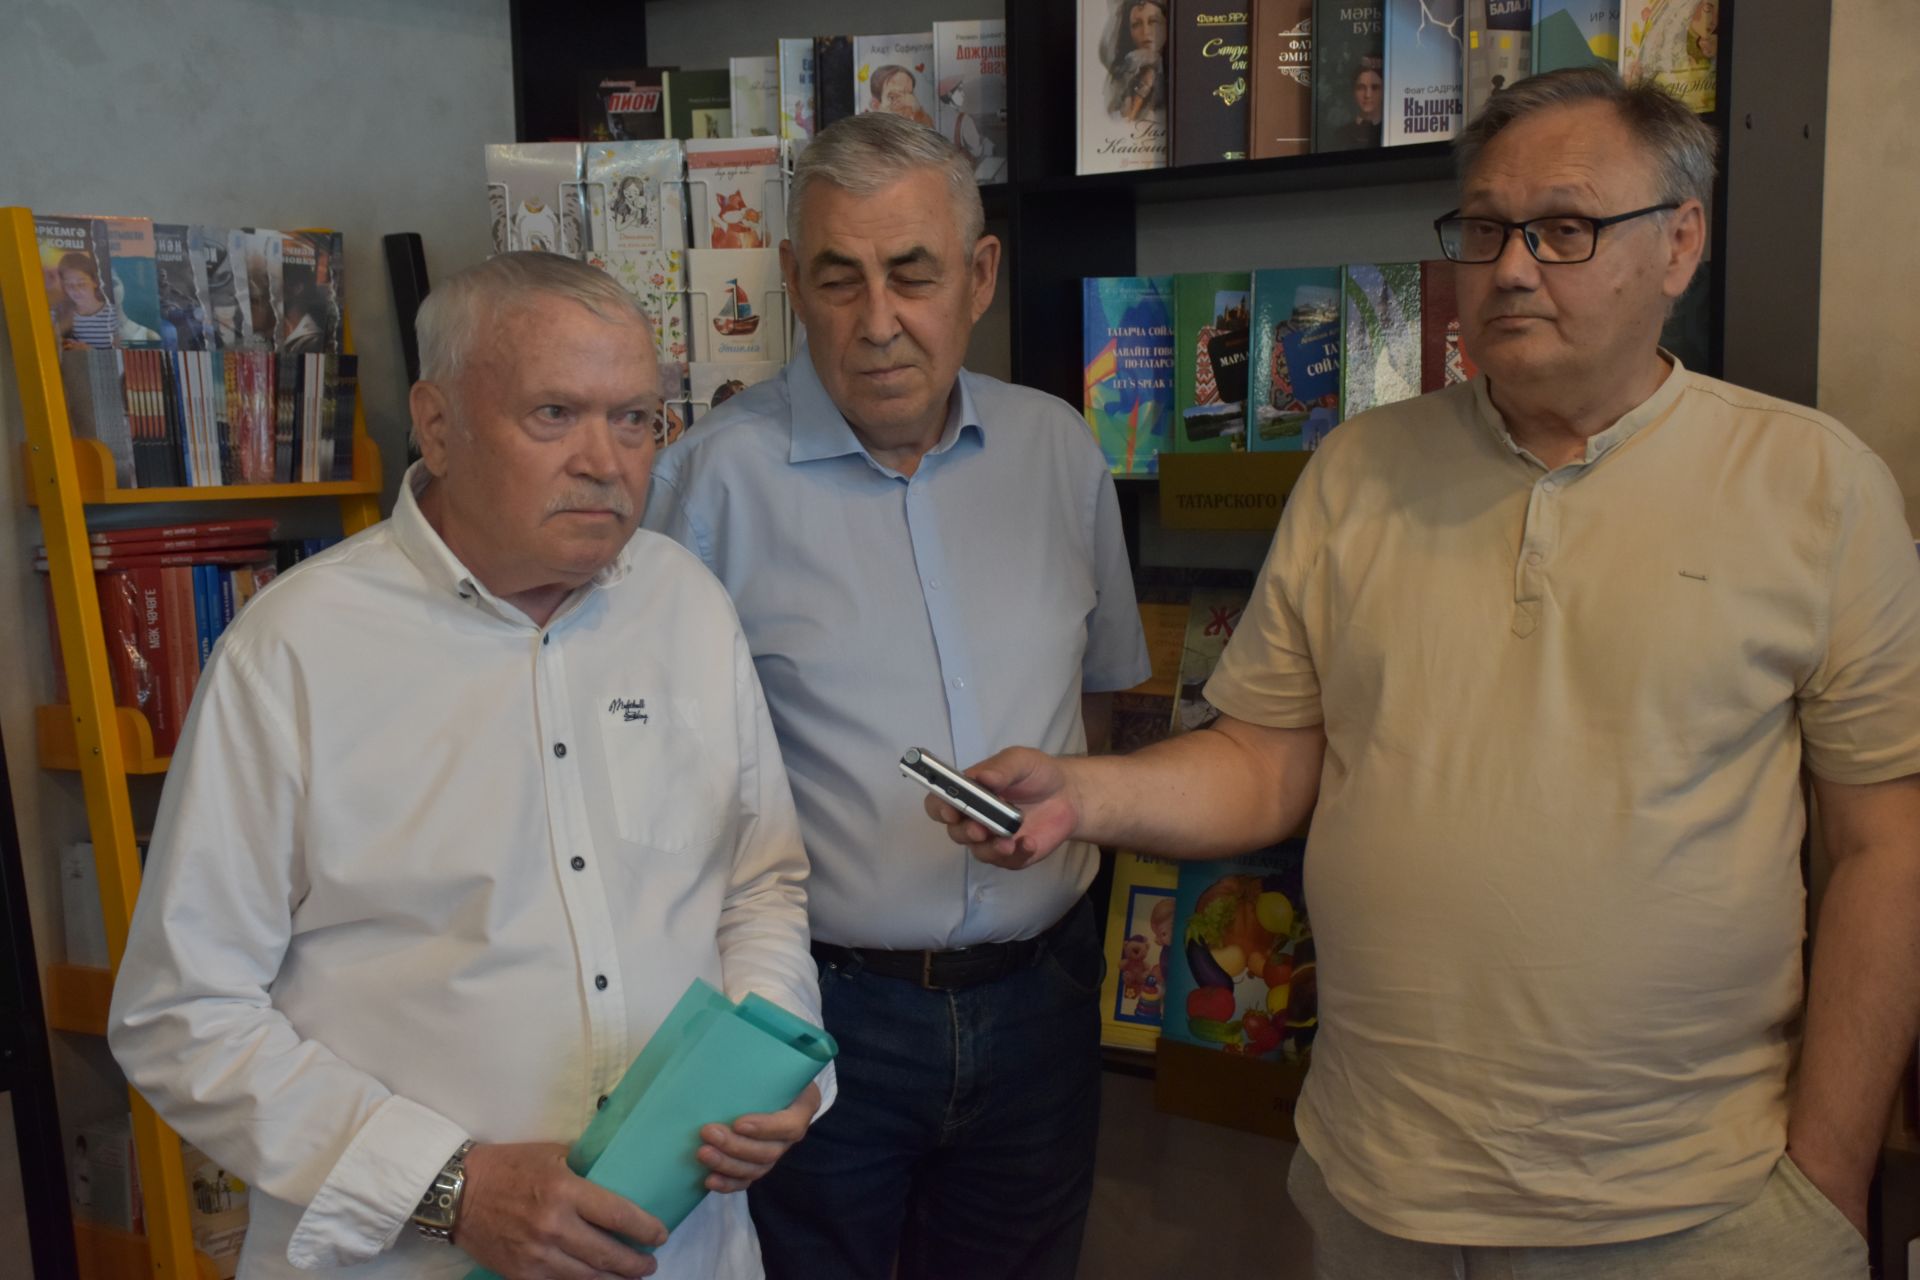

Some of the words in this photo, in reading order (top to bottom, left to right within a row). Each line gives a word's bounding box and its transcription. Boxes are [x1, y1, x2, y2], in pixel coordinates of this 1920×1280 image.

[1278, 52, 1311, 62] ӘМИ
[609, 94, 657, 111] ПИОН
[1404, 115, 1449, 134] яшен
[1176, 493, 1277, 510] ТАТАРСКОГО
